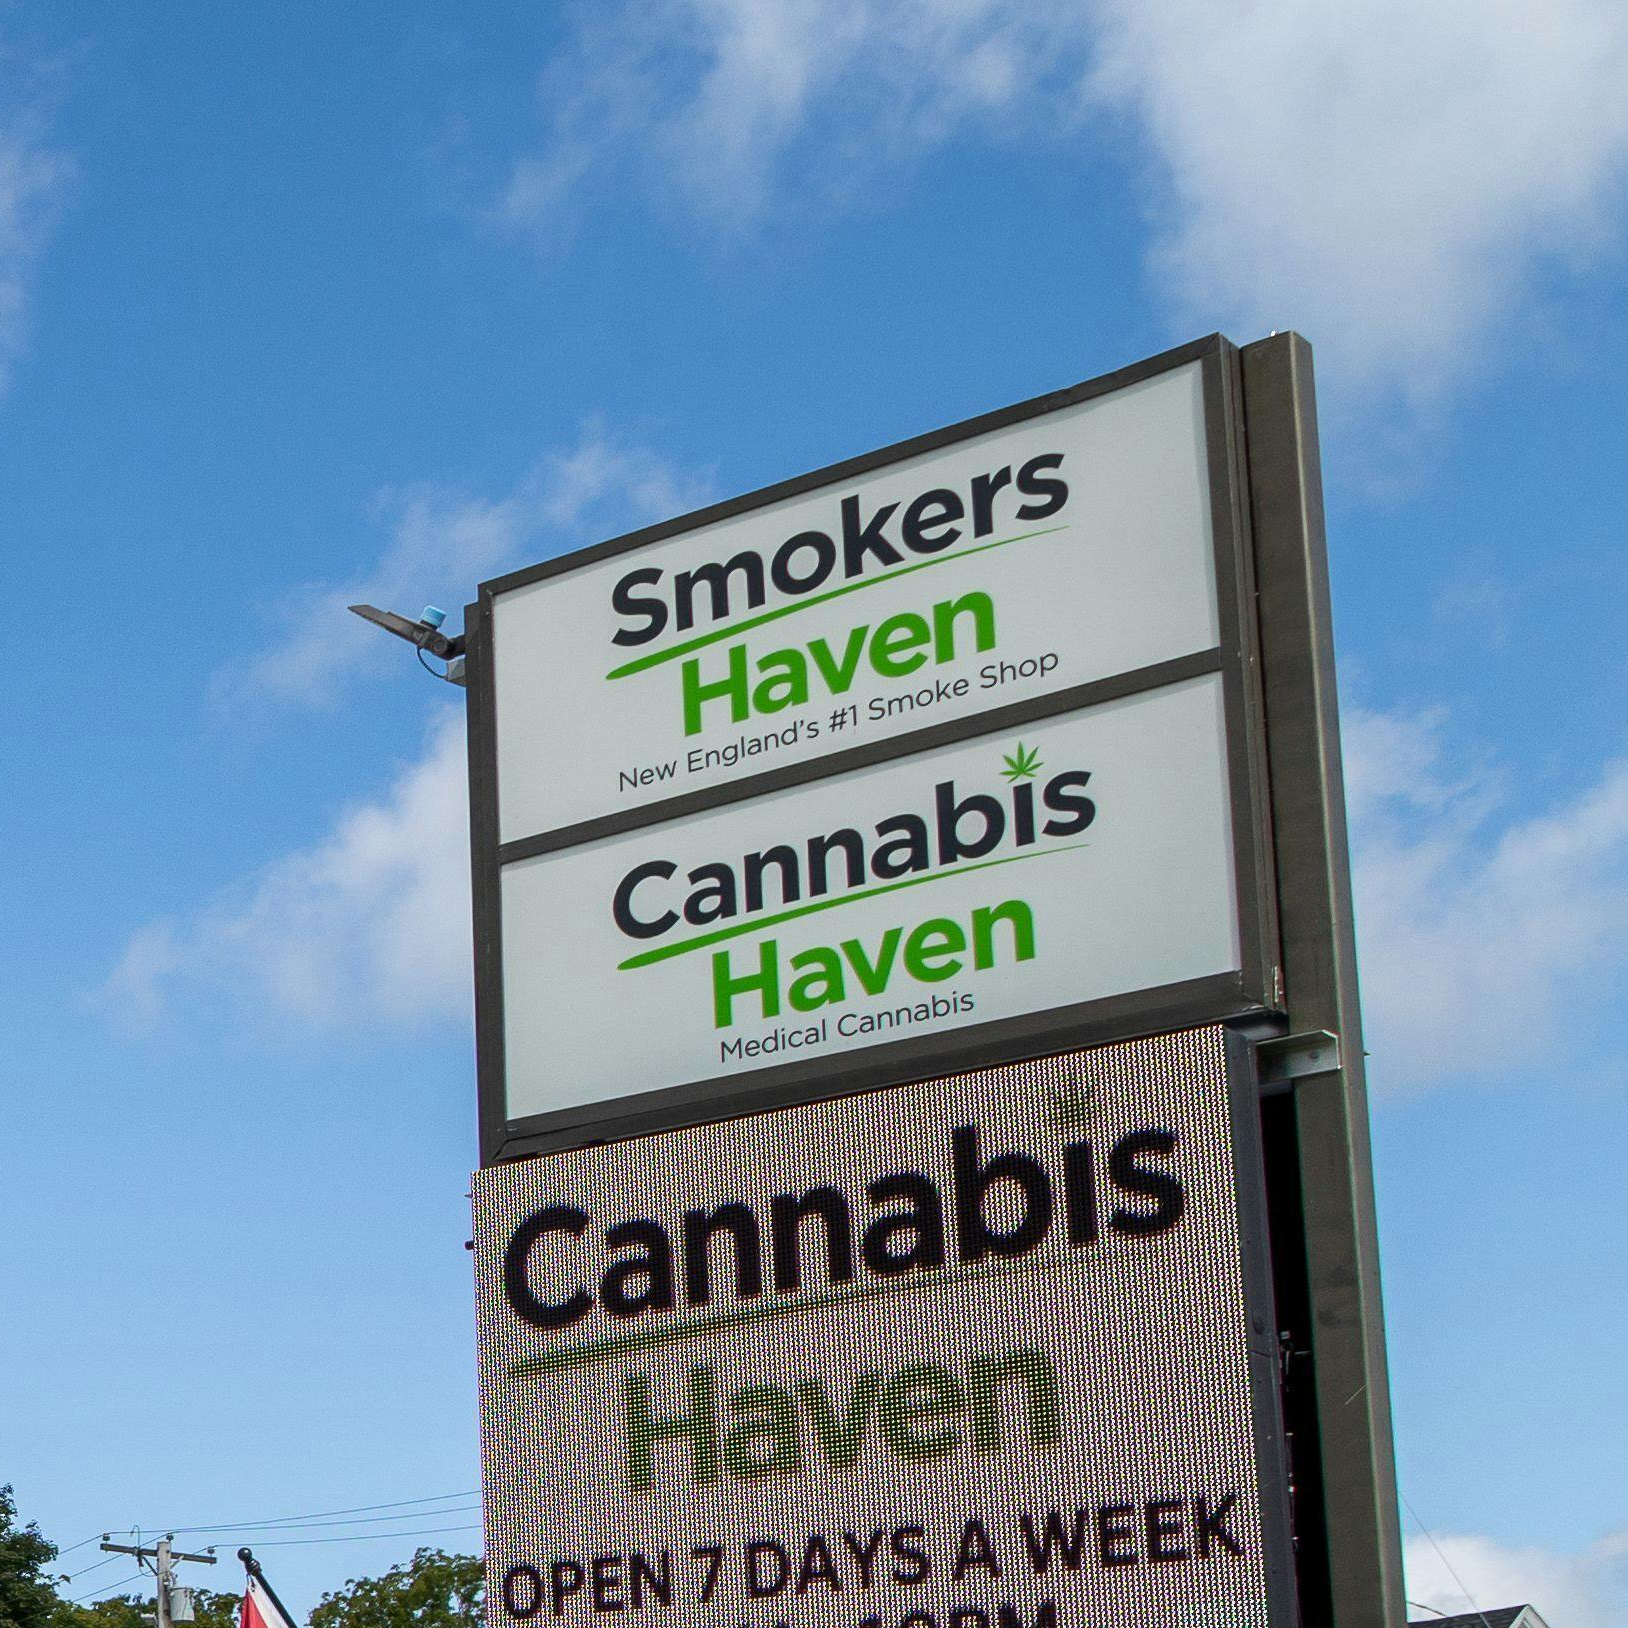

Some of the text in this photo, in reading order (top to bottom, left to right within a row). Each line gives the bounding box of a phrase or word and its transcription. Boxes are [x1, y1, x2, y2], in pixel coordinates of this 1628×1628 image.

[611, 452, 1070, 648] Smokers
[618, 648, 1061, 793] New England's #1 Smoke Shop
[680, 590, 997, 738] Haven
[612, 769, 1098, 940] Cannabis
[712, 898, 1037, 1030] Haven
[719, 990, 976, 1064] Medical Cannabis
[502, 1122, 1187, 1332] Cannabis
[624, 1345, 1061, 1493] Haven
[502, 1491, 1247, 1620] OPEN 7 DAYS A WEEK
